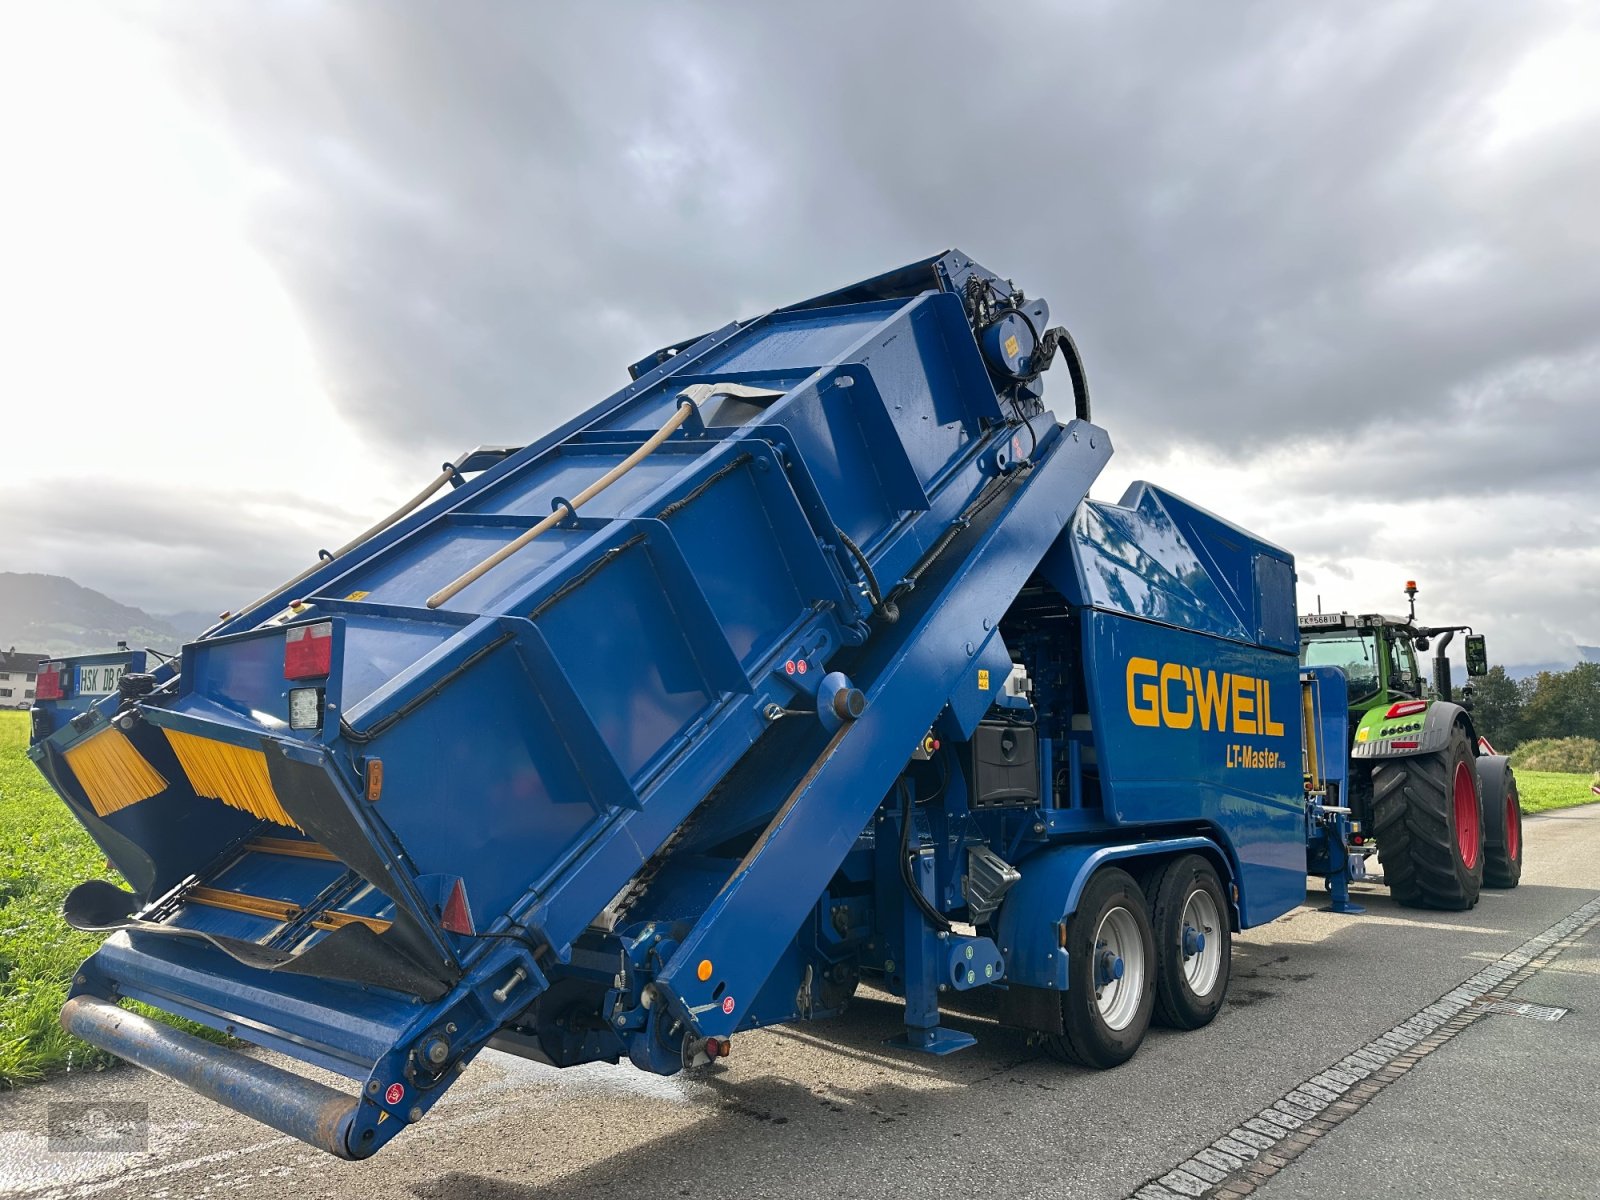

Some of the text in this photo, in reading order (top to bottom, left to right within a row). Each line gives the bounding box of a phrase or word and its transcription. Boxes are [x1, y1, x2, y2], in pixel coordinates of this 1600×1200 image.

[1300, 617, 1309, 625] FK
[81, 668, 98, 691] HSK
[102, 668, 114, 691] DB
[1226, 744, 1279, 768] LT-Master
